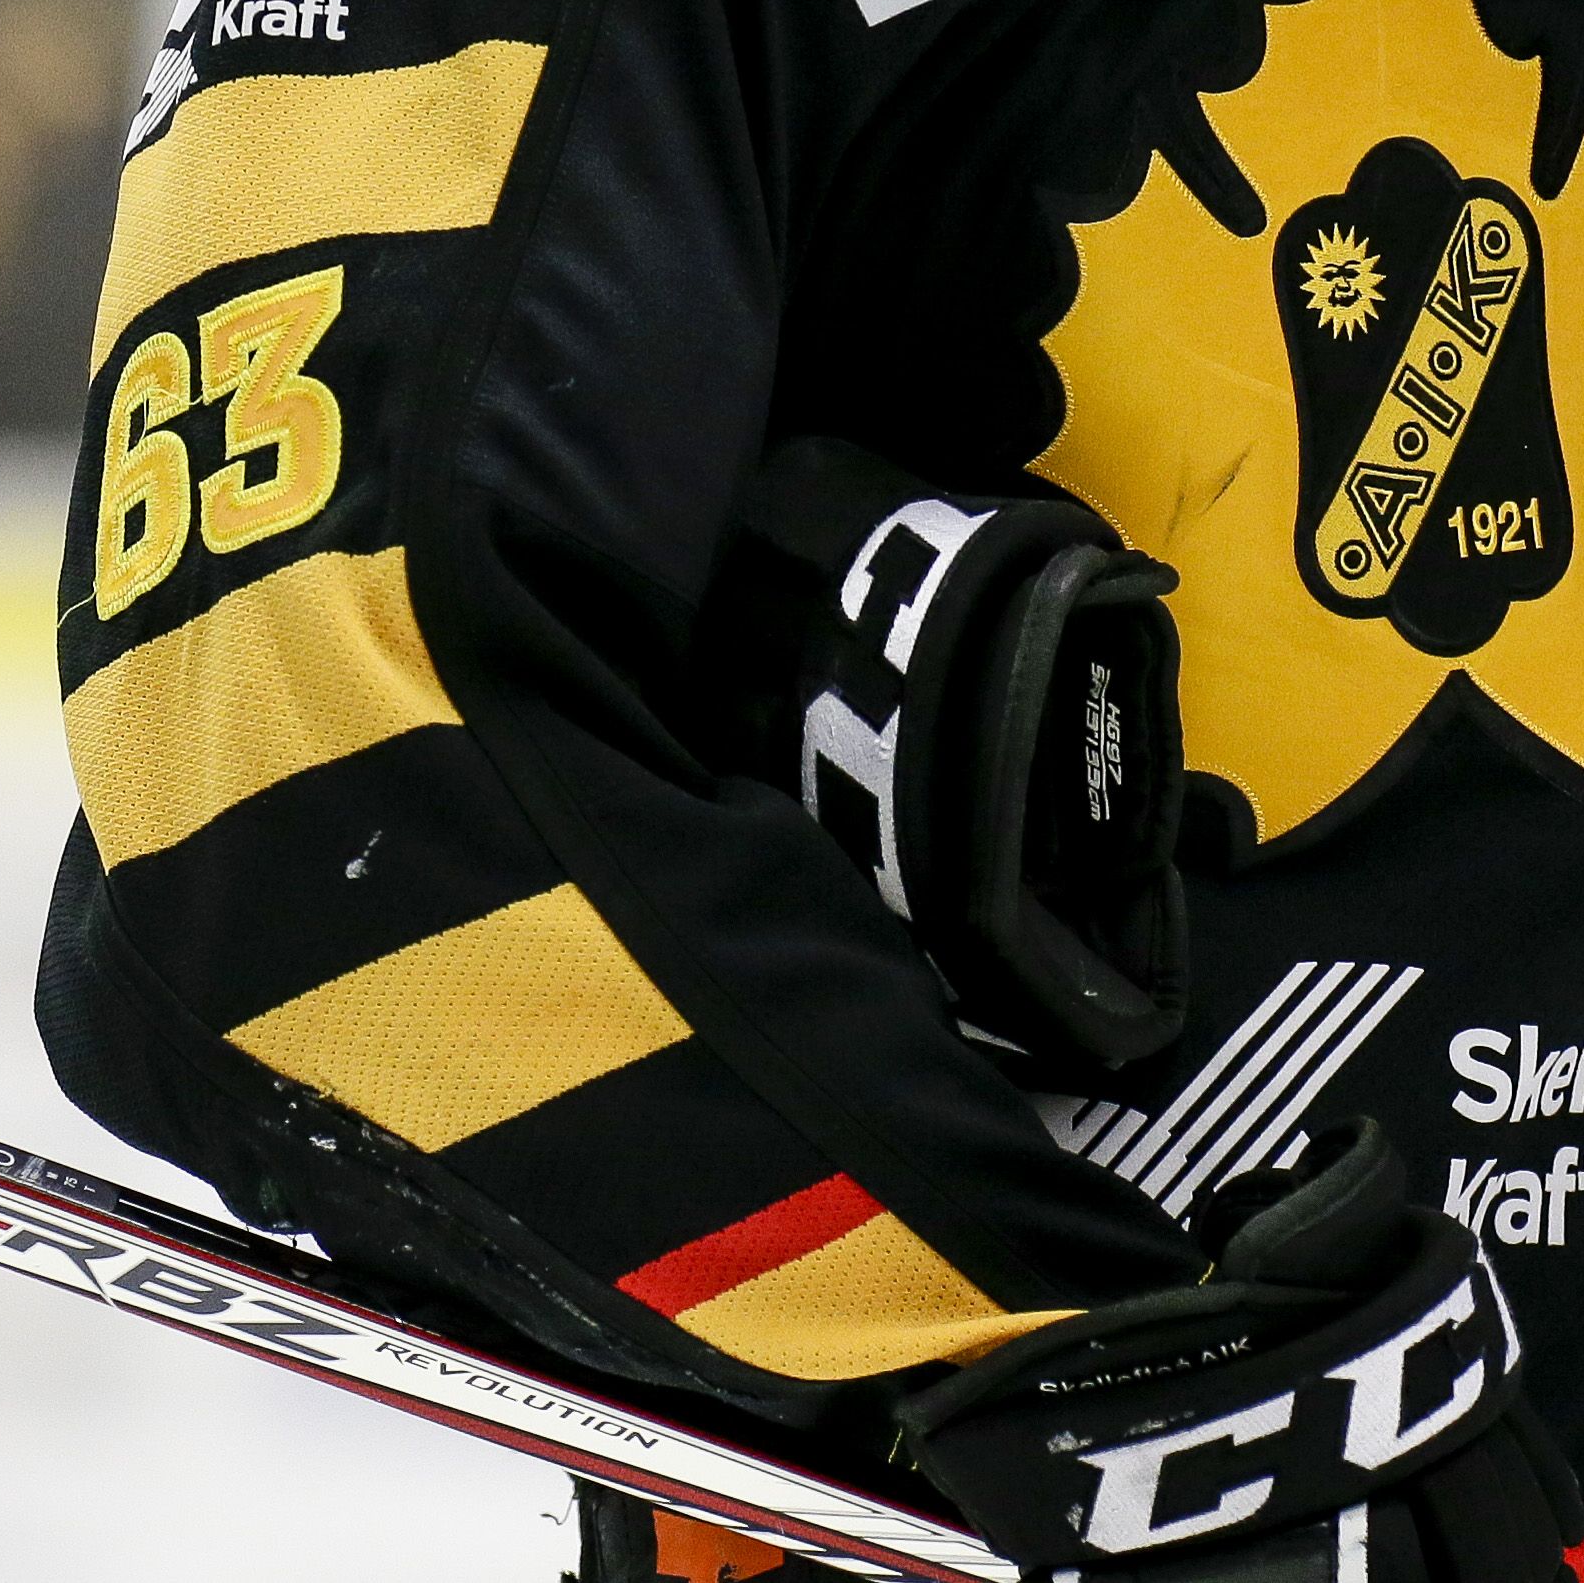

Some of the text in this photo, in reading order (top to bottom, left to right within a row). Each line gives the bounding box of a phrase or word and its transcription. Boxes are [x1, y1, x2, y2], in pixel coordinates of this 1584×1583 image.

[95, 264, 344, 621] 63
[1447, 497, 1545, 558] 1921
[375, 1340, 659, 1450] REVOLUTION
